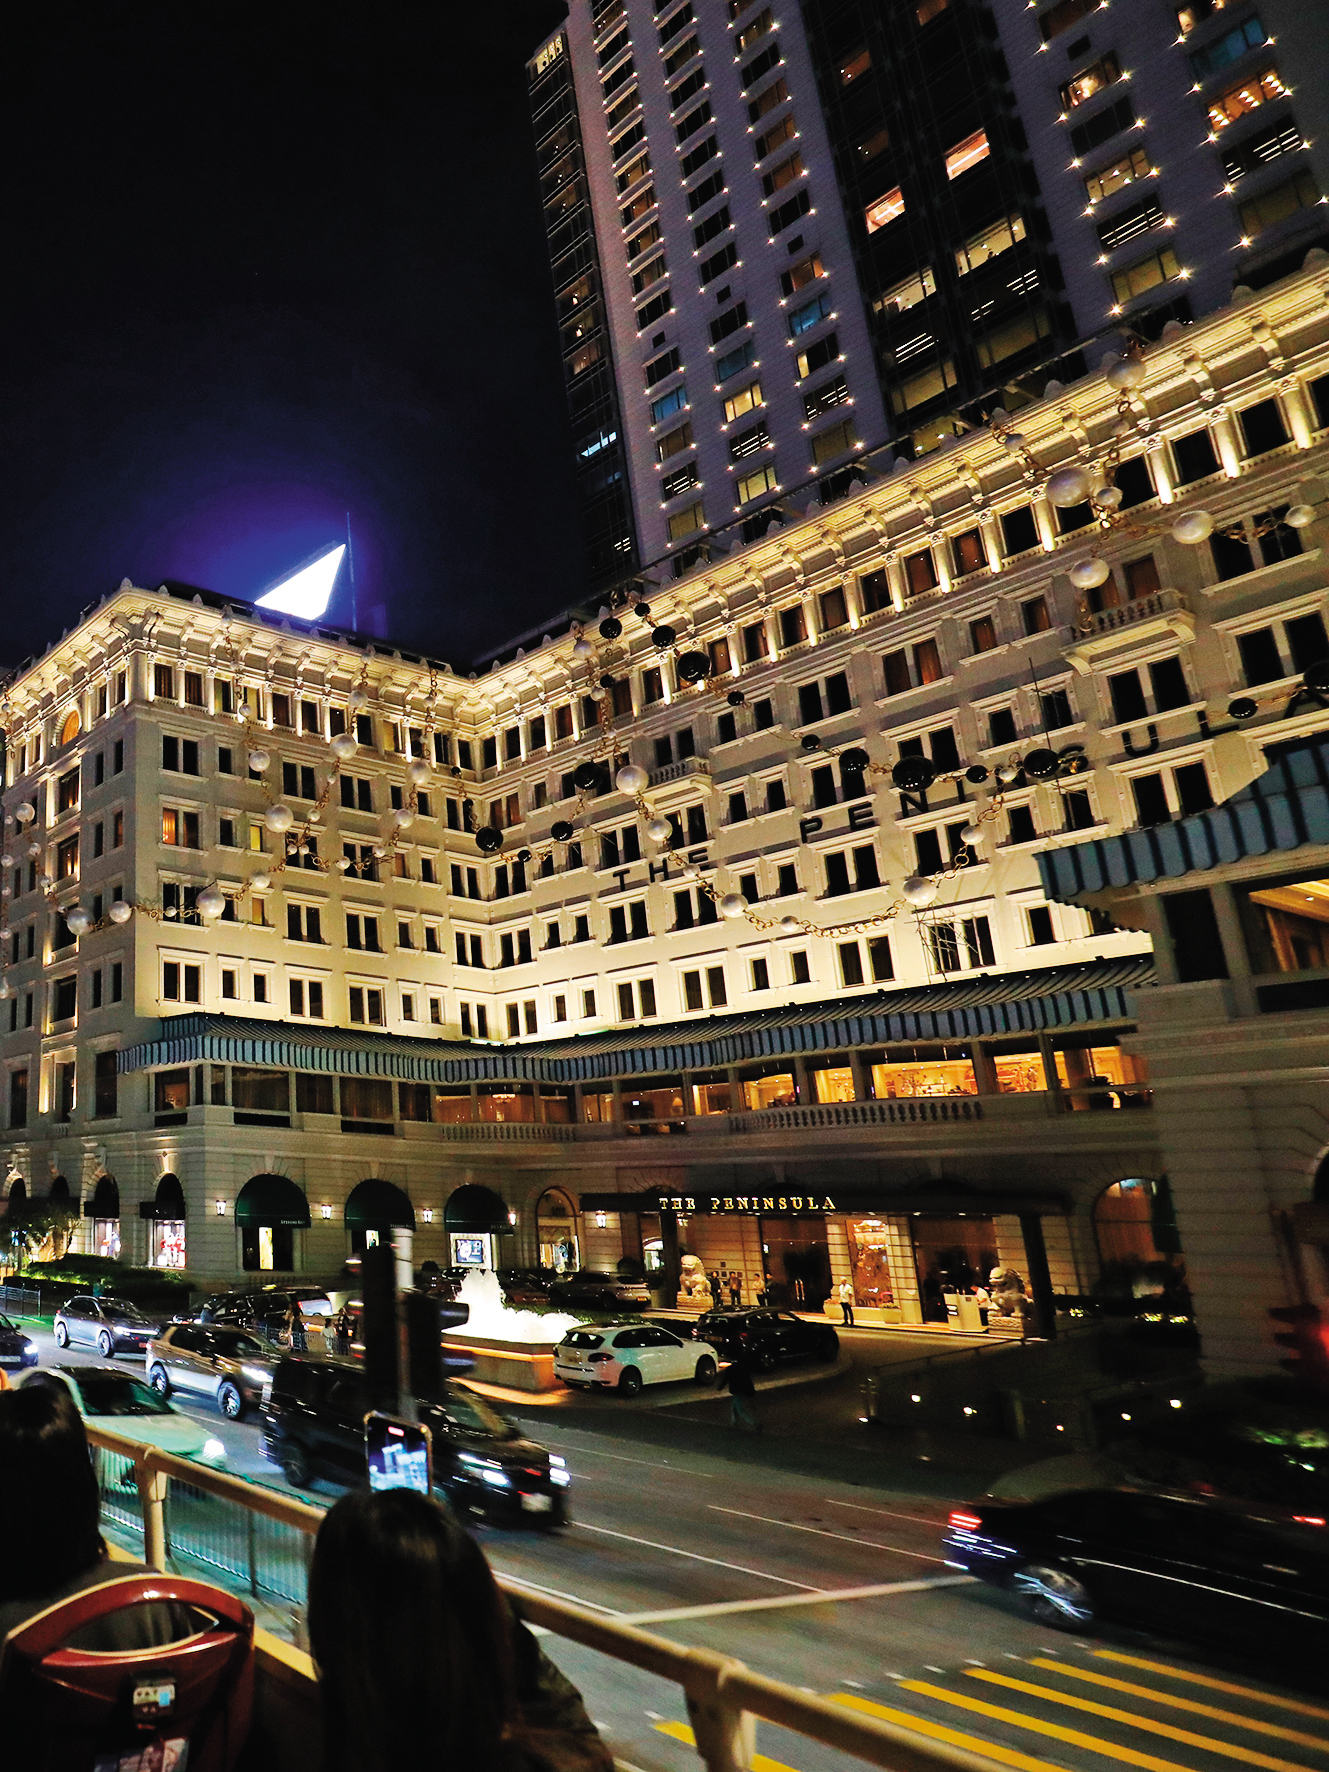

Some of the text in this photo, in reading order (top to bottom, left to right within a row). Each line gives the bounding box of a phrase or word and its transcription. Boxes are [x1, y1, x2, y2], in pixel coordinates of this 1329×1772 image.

[612, 847, 710, 892] THE
[658, 1196, 837, 1210] THE PENINSULA
